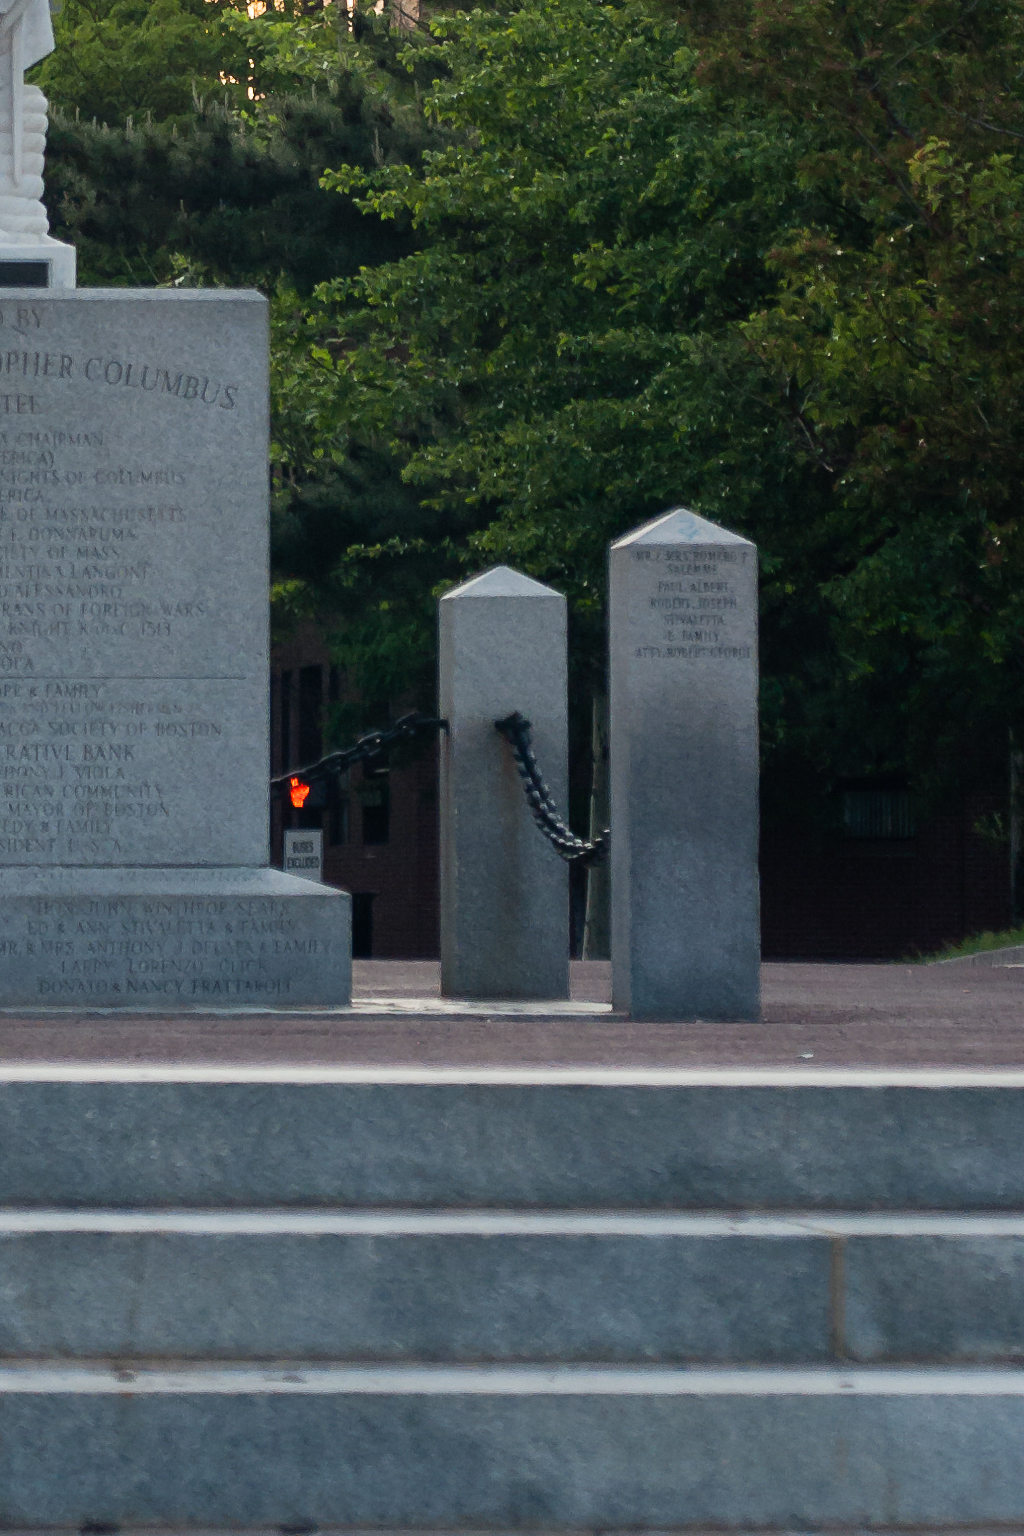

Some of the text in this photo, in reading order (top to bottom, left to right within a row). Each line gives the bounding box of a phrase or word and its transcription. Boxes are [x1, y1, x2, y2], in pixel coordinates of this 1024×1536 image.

[16, 307, 43, 329] BY
[84, 356, 239, 410] COLUMBUS
[94, 468, 187, 485] COLUMBUS
[16, 506, 39, 523] OF
[45, 506, 188, 523] MASSACHUSETTS
[46, 544, 68, 561] OF
[658, 580, 683, 594] PAUL
[53, 601, 74, 618] OF
[160, 601, 206, 618] WARS
[45, 681, 106, 699] FAMILY
[47, 720, 119, 738] SOCIETY
[126, 720, 147, 738] OF
[155, 720, 223, 738] BOSTON
[82, 742, 136, 763] BANK
[75, 764, 126, 781] VIOLA
[61, 783, 167, 800] COMMUNITY
[8, 801, 66, 819] MAYOR
[73, 801, 97, 819] OF
[103, 801, 170, 819] BOSTON
[56, 819, 114, 835] FAMILY
[292, 841, 314, 854] BUSES
[26, 919, 49, 936] ED
[77, 919, 112, 936] ANN
[239, 919, 298, 936] FAMILY
[86, 939, 166, 956] ANTHONY
[275, 939, 332, 956] FAMILY
[38, 978, 109, 995] DONATO
[126, 978, 182, 995] NANCY
